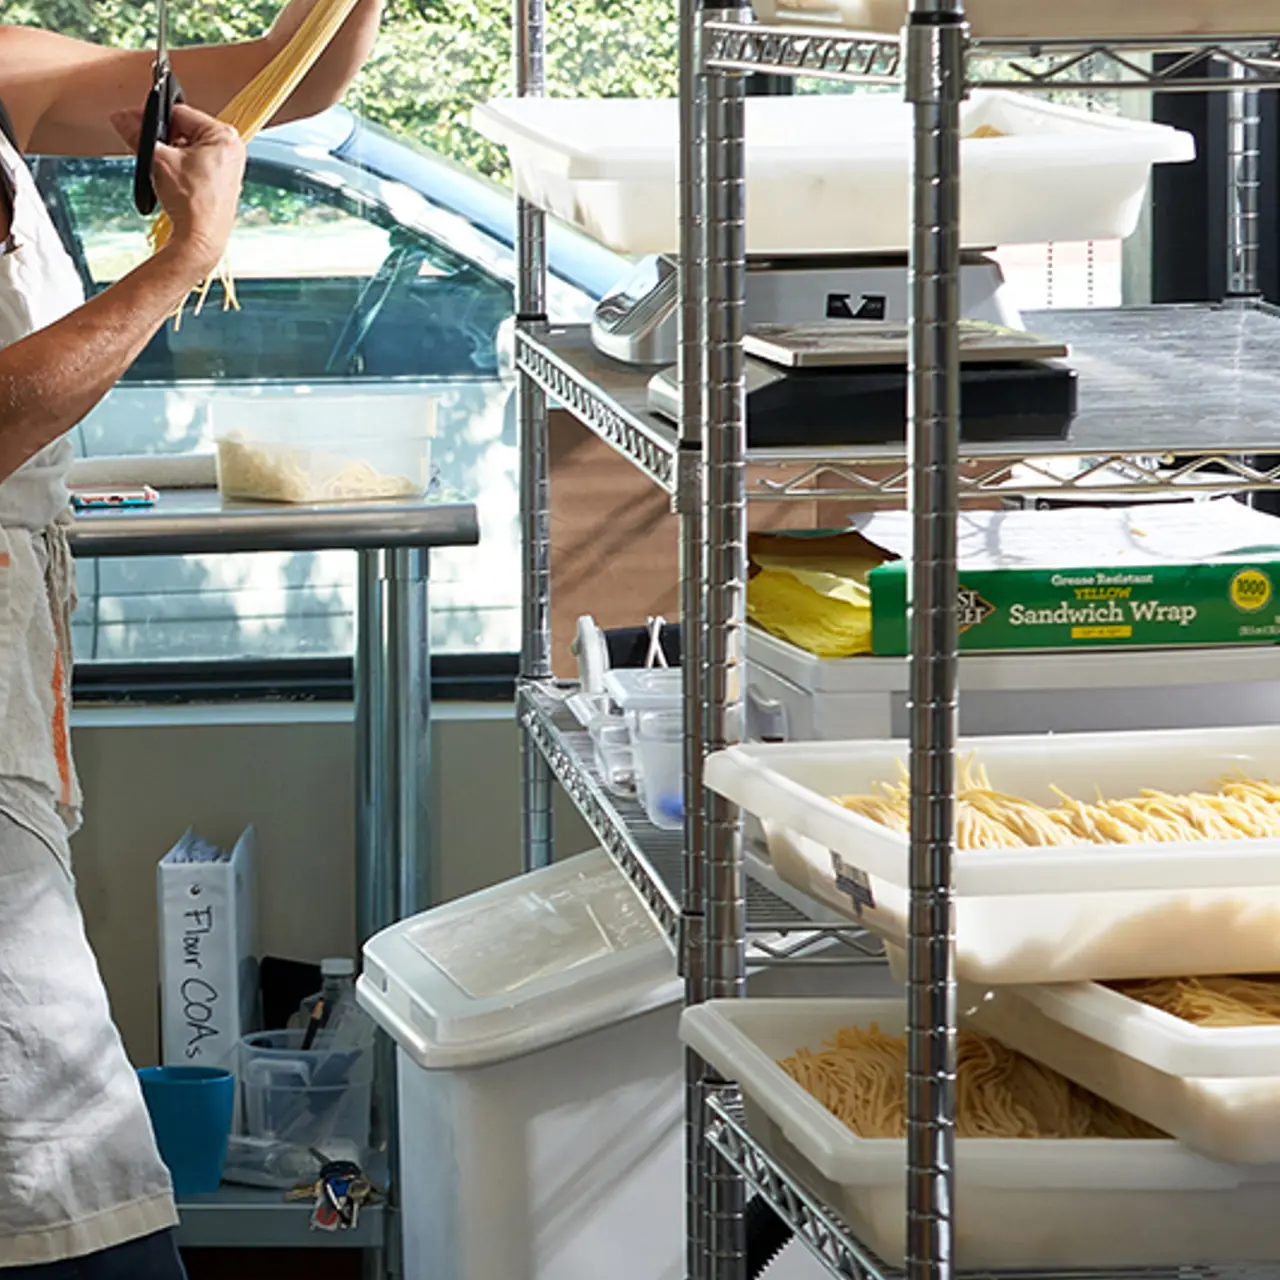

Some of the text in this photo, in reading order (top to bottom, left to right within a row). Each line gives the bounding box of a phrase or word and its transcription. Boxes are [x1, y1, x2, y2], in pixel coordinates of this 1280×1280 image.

[1051, 572, 1154, 587] Grease Resistant
[1073, 586, 1133, 600] YELLOW
[1009, 600, 1124, 626] Sandwich
[1128, 600, 1197, 626] Wrap
[180, 904, 220, 1060] Flour COAs
